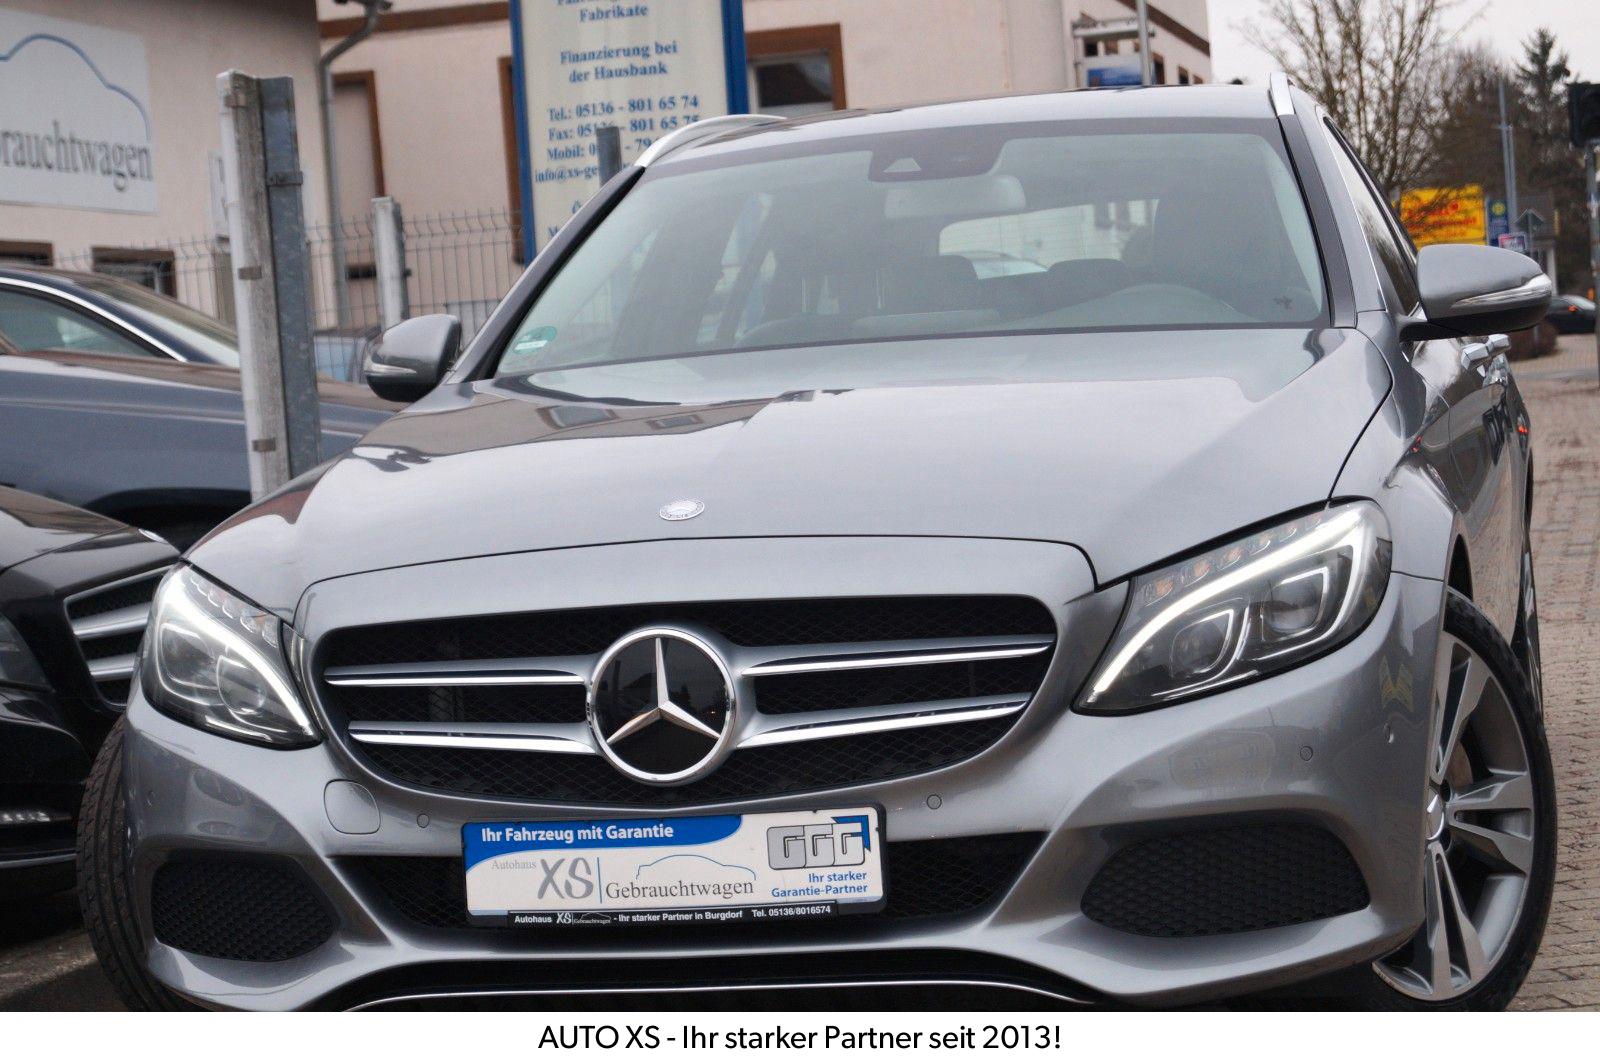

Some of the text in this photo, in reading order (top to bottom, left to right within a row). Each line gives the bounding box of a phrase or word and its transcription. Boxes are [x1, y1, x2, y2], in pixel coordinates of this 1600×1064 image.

[579, 6, 648, 22] Fabrikate
[560, 41, 678, 65] Finanzierung bei
[569, 61, 668, 84] der Hausbank
[576, 102, 614, 118] 05136
[628, 97, 653, 112] 801
[659, 96, 676, 110] 65
[682, 95, 699, 109] 74
[548, 127, 573, 141] Fax:
[629, 118, 654, 132] 801
[660, 116, 677, 129] 65
[547, 145, 584, 161] Mobil:
[482, 823, 674, 844] Ihr Fahrzeug mit Garantie
[491, 857, 754, 900] Autohaus XS Gebrauchtwagen
[808, 871, 867, 883] Ihr starker
[771, 884, 868, 898] Garantie-Partner
[514, 915, 552, 923] Autohaus
[556, 912, 572, 924] XS
[618, 914, 631, 922] Ihr
[632, 912, 660, 922] starker
[662, 911, 693, 921] Partner
[695, 911, 703, 920] in
[705, 910, 743, 921] Burgdorf
[751, 908, 767, 918] Tel.
[768, 905, 832, 917] 05136/8016574
